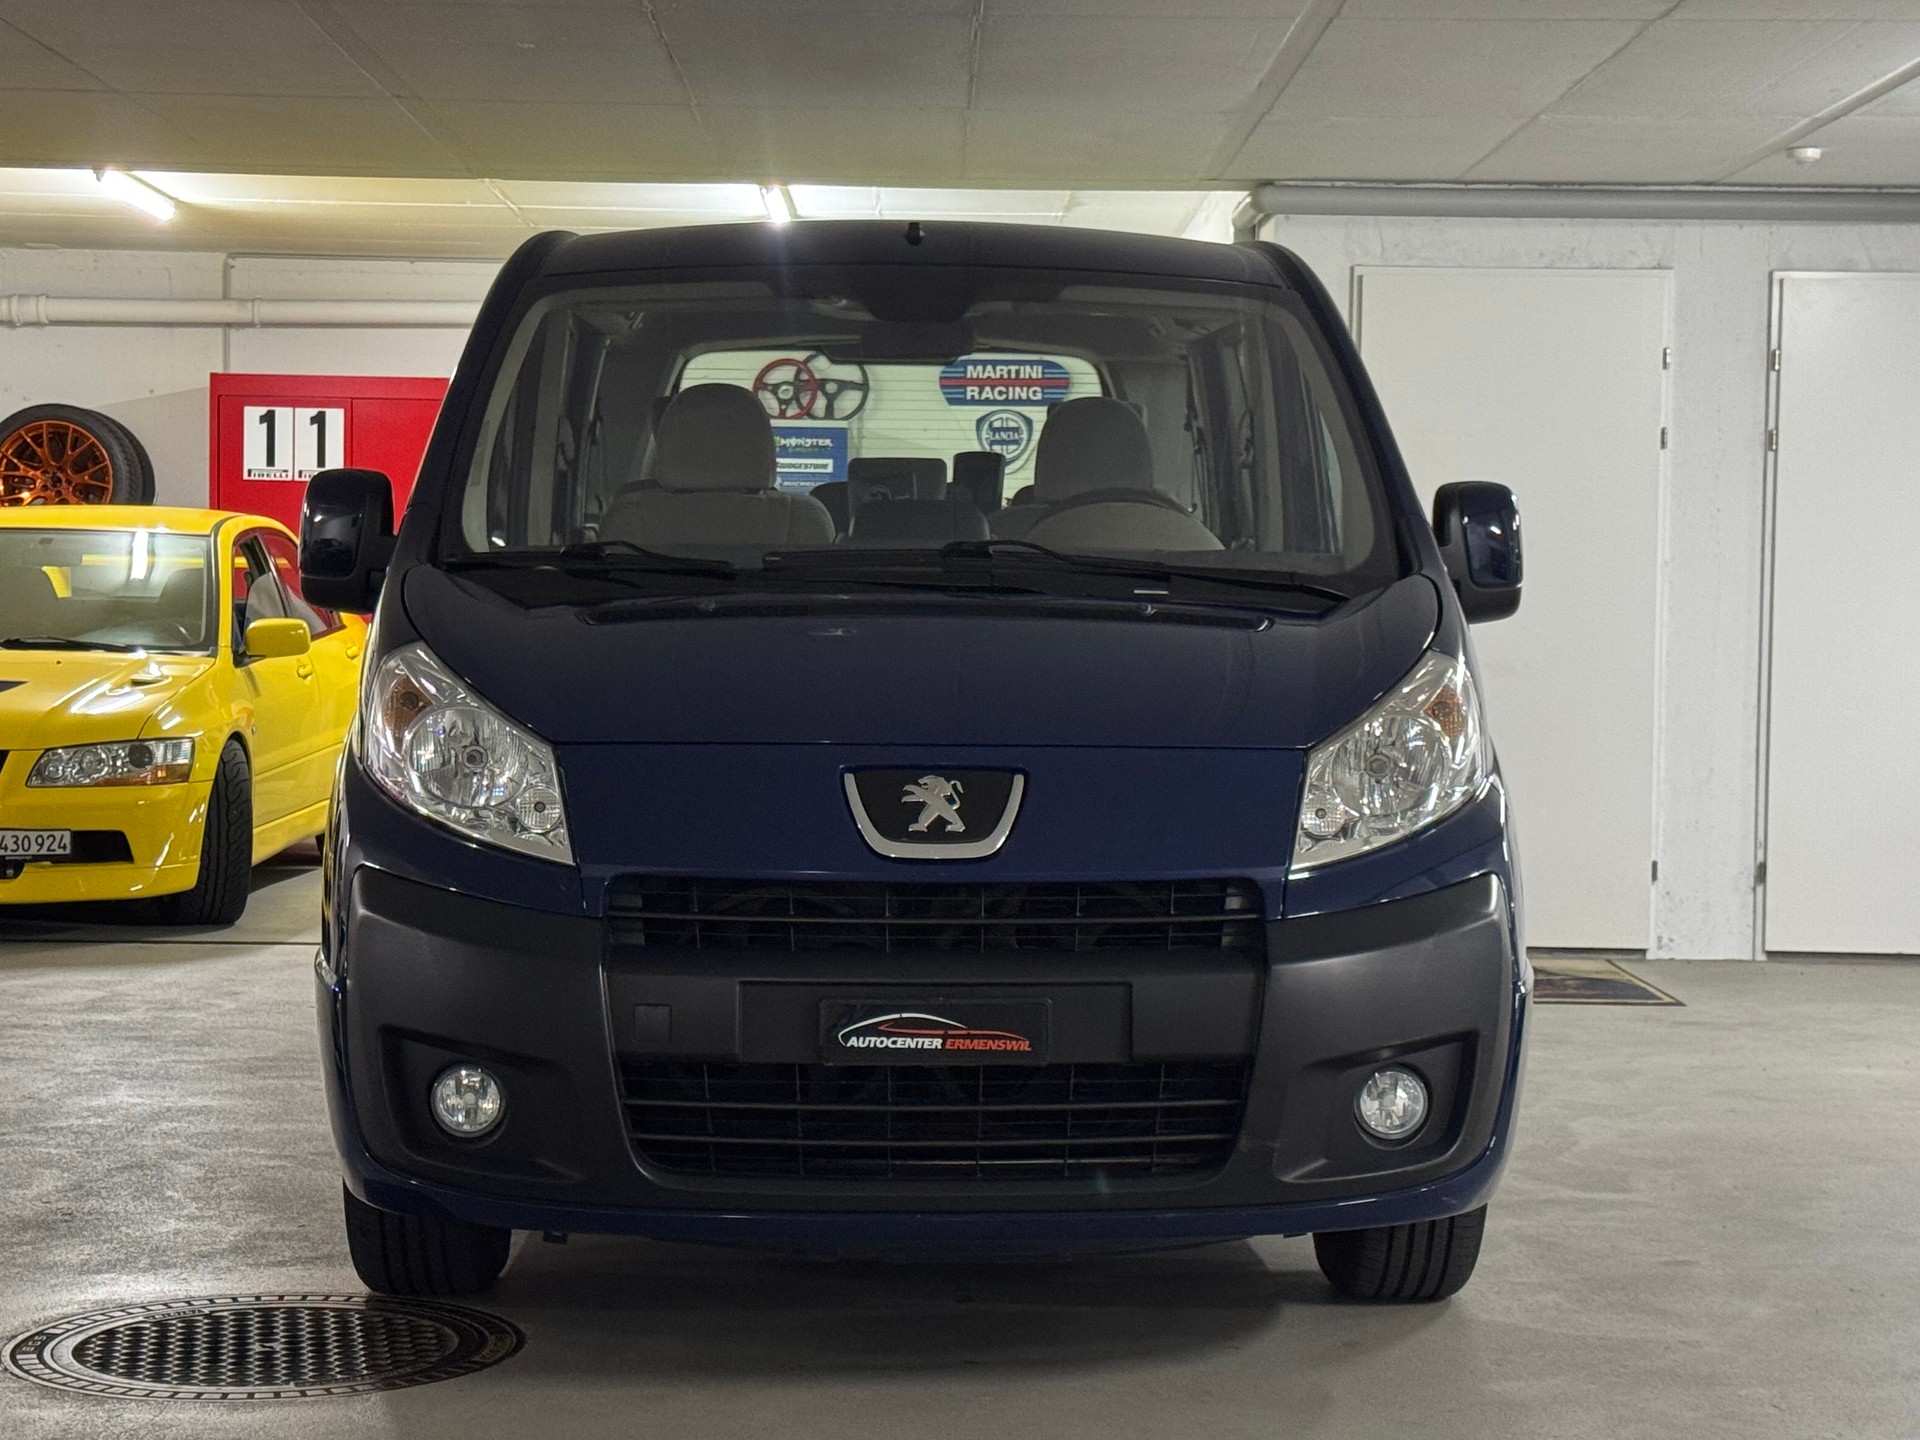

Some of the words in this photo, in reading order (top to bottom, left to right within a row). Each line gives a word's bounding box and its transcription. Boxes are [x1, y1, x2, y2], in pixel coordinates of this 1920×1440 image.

[966, 365, 1043, 379] MARTINI
[966, 386, 1043, 401] RACING
[989, 430, 1020, 441] LANCIA
[780, 437, 833, 447] MONSTER
[247, 469, 289, 478] PIRELLI
[847, 1036, 943, 1049] AUTOCENTER
[945, 1038, 1031, 1051] ERMENSWIL
